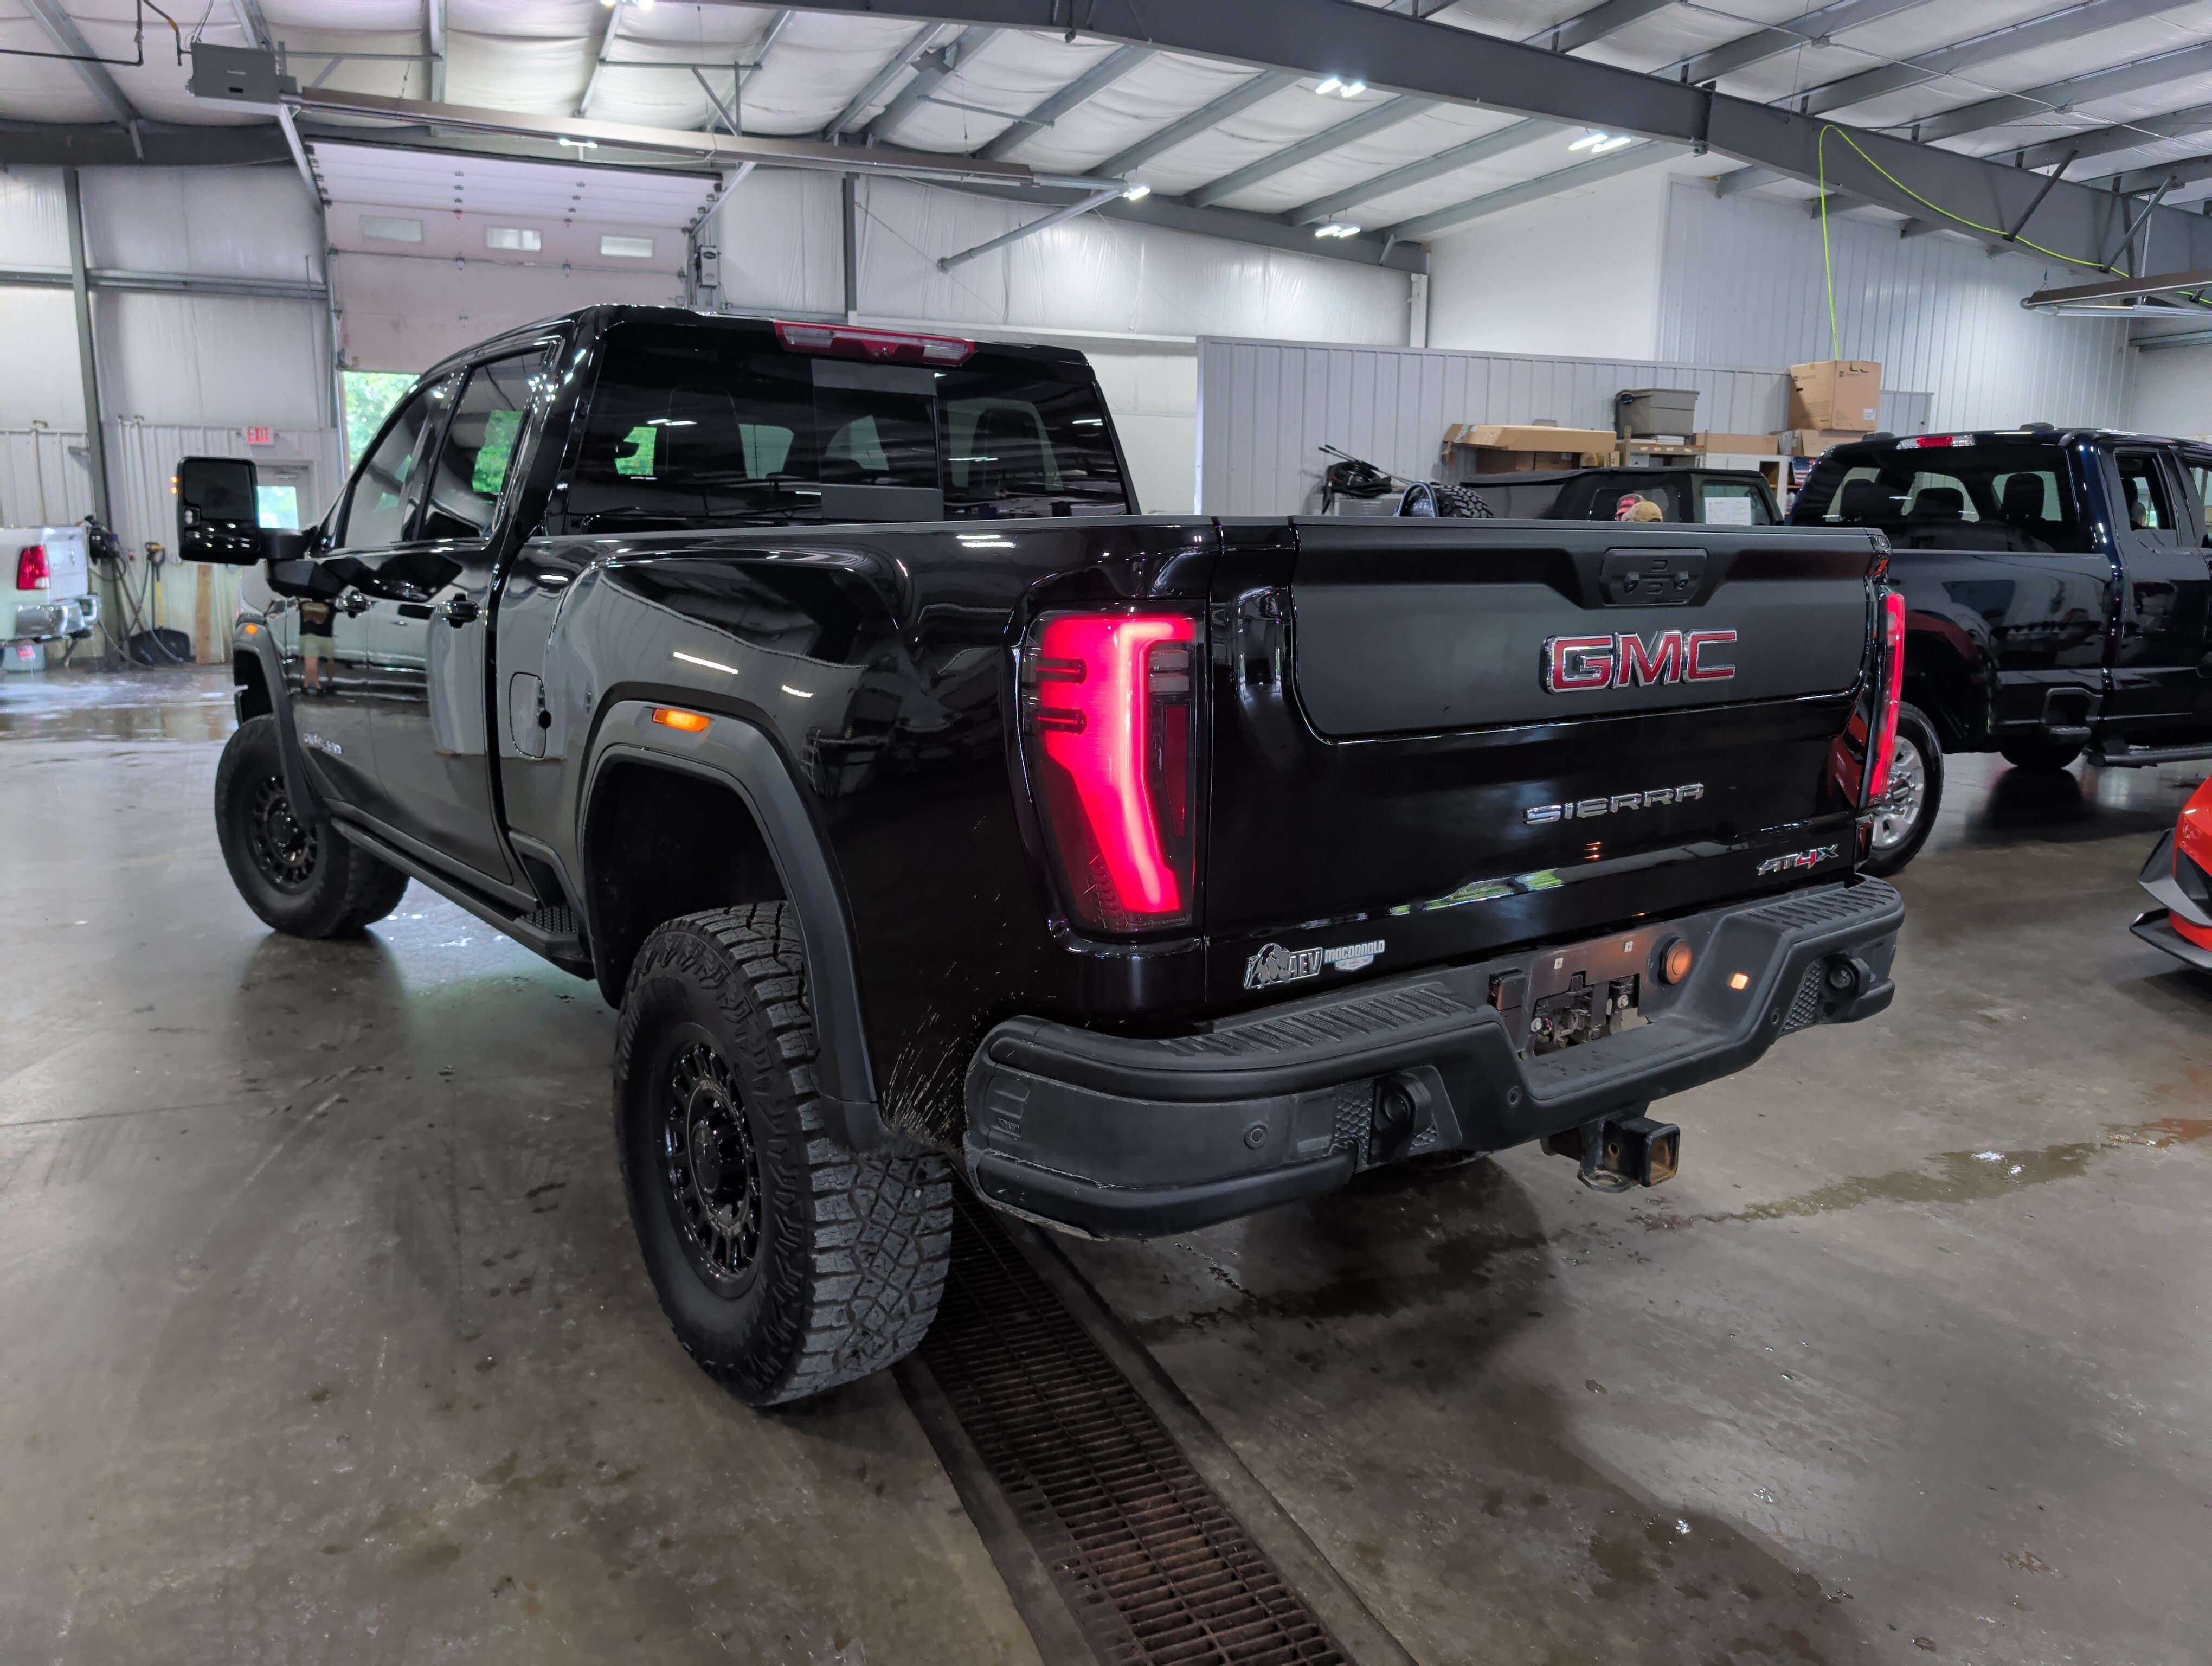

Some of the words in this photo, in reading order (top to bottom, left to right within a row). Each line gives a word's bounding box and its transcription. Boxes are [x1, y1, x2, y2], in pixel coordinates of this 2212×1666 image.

[248, 426, 269, 443] EXIT
[1539, 629, 1737, 693] GMC
[1523, 783, 1704, 825] SIERRA
[1757, 844, 1839, 875] AT4X
[1288, 951, 1321, 977] AEV
